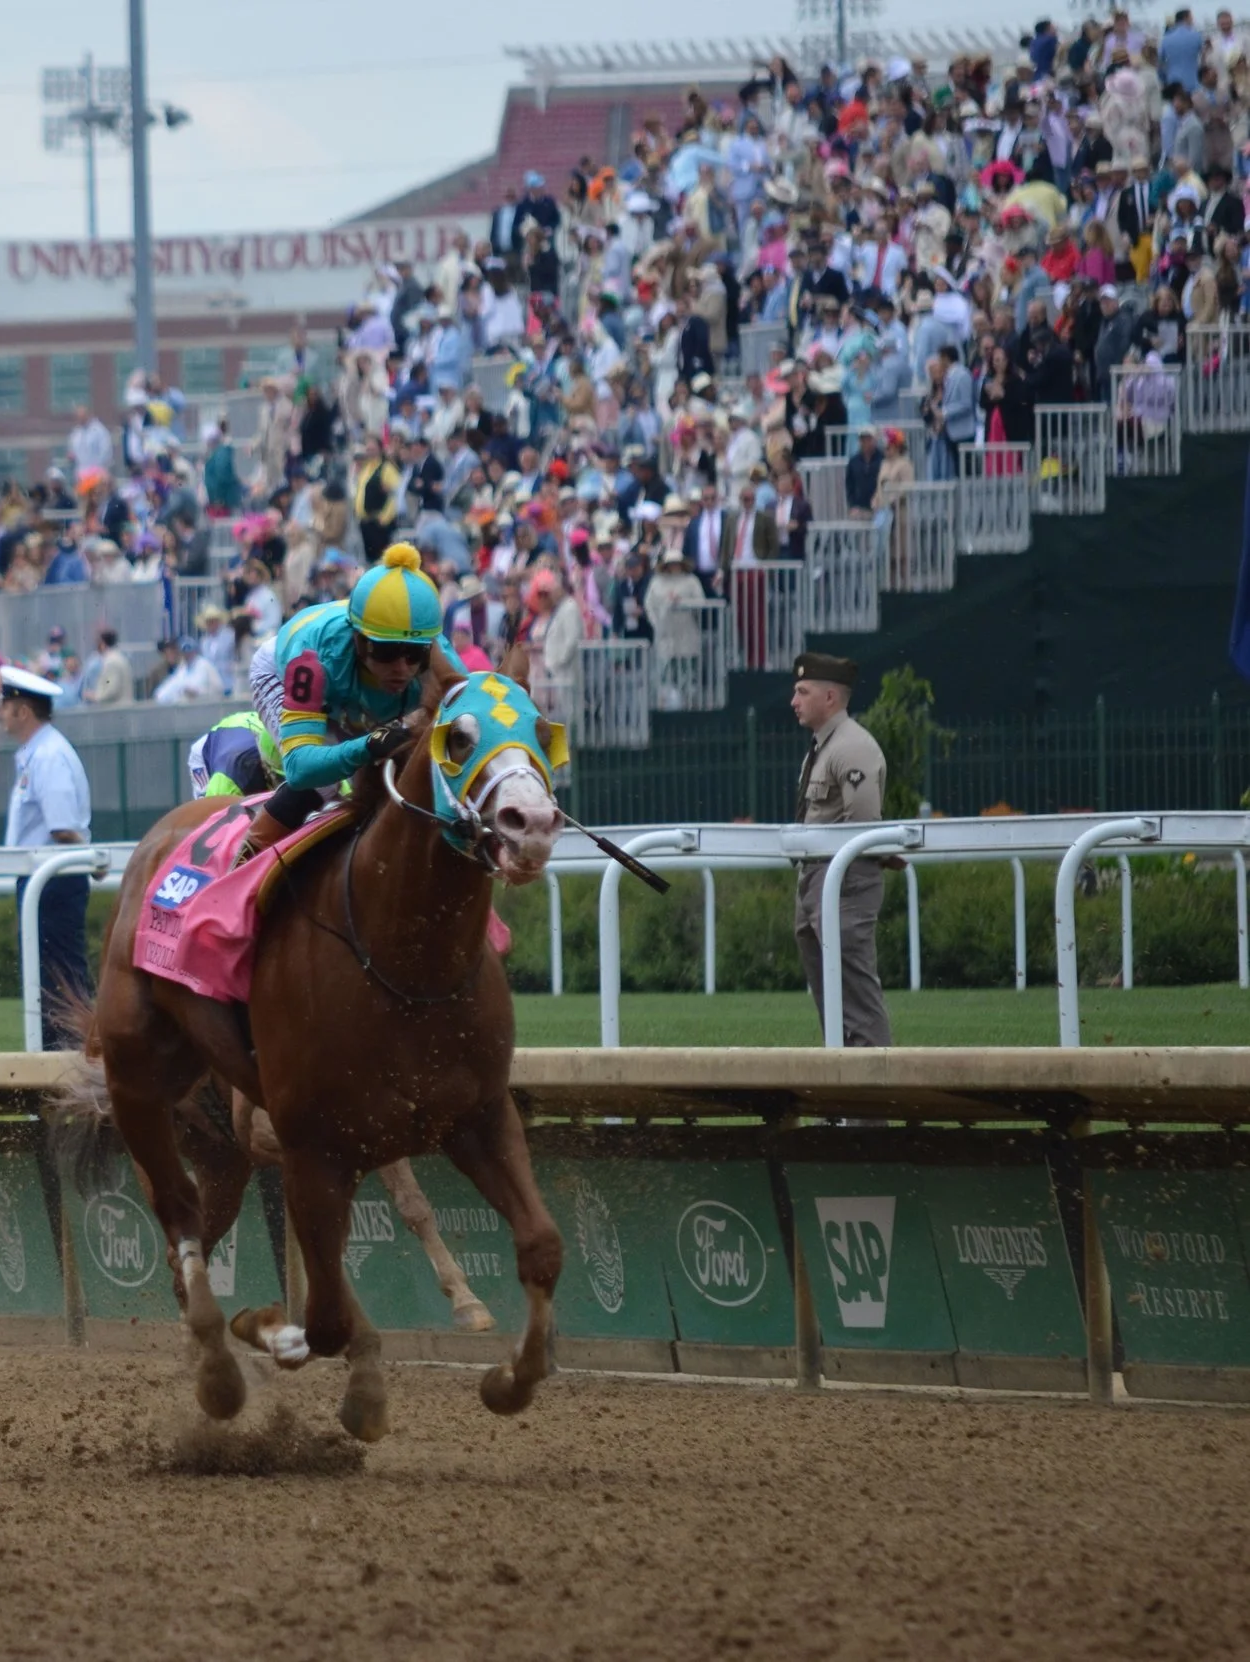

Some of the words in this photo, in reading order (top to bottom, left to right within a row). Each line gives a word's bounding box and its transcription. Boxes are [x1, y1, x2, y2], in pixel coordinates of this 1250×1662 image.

[291, 664, 314, 703] 8
[156, 871, 199, 904] SAP
[98, 1203, 146, 1271] Ford
[434, 1207, 500, 1233] OODFORD
[693, 1214, 750, 1287] Ford
[823, 1220, 888, 1304] SAP
[952, 1224, 1048, 1267] LONGINES
[1112, 1224, 1226, 1265] WOODFORD
[1134, 1281, 1230, 1320] RESERVE
